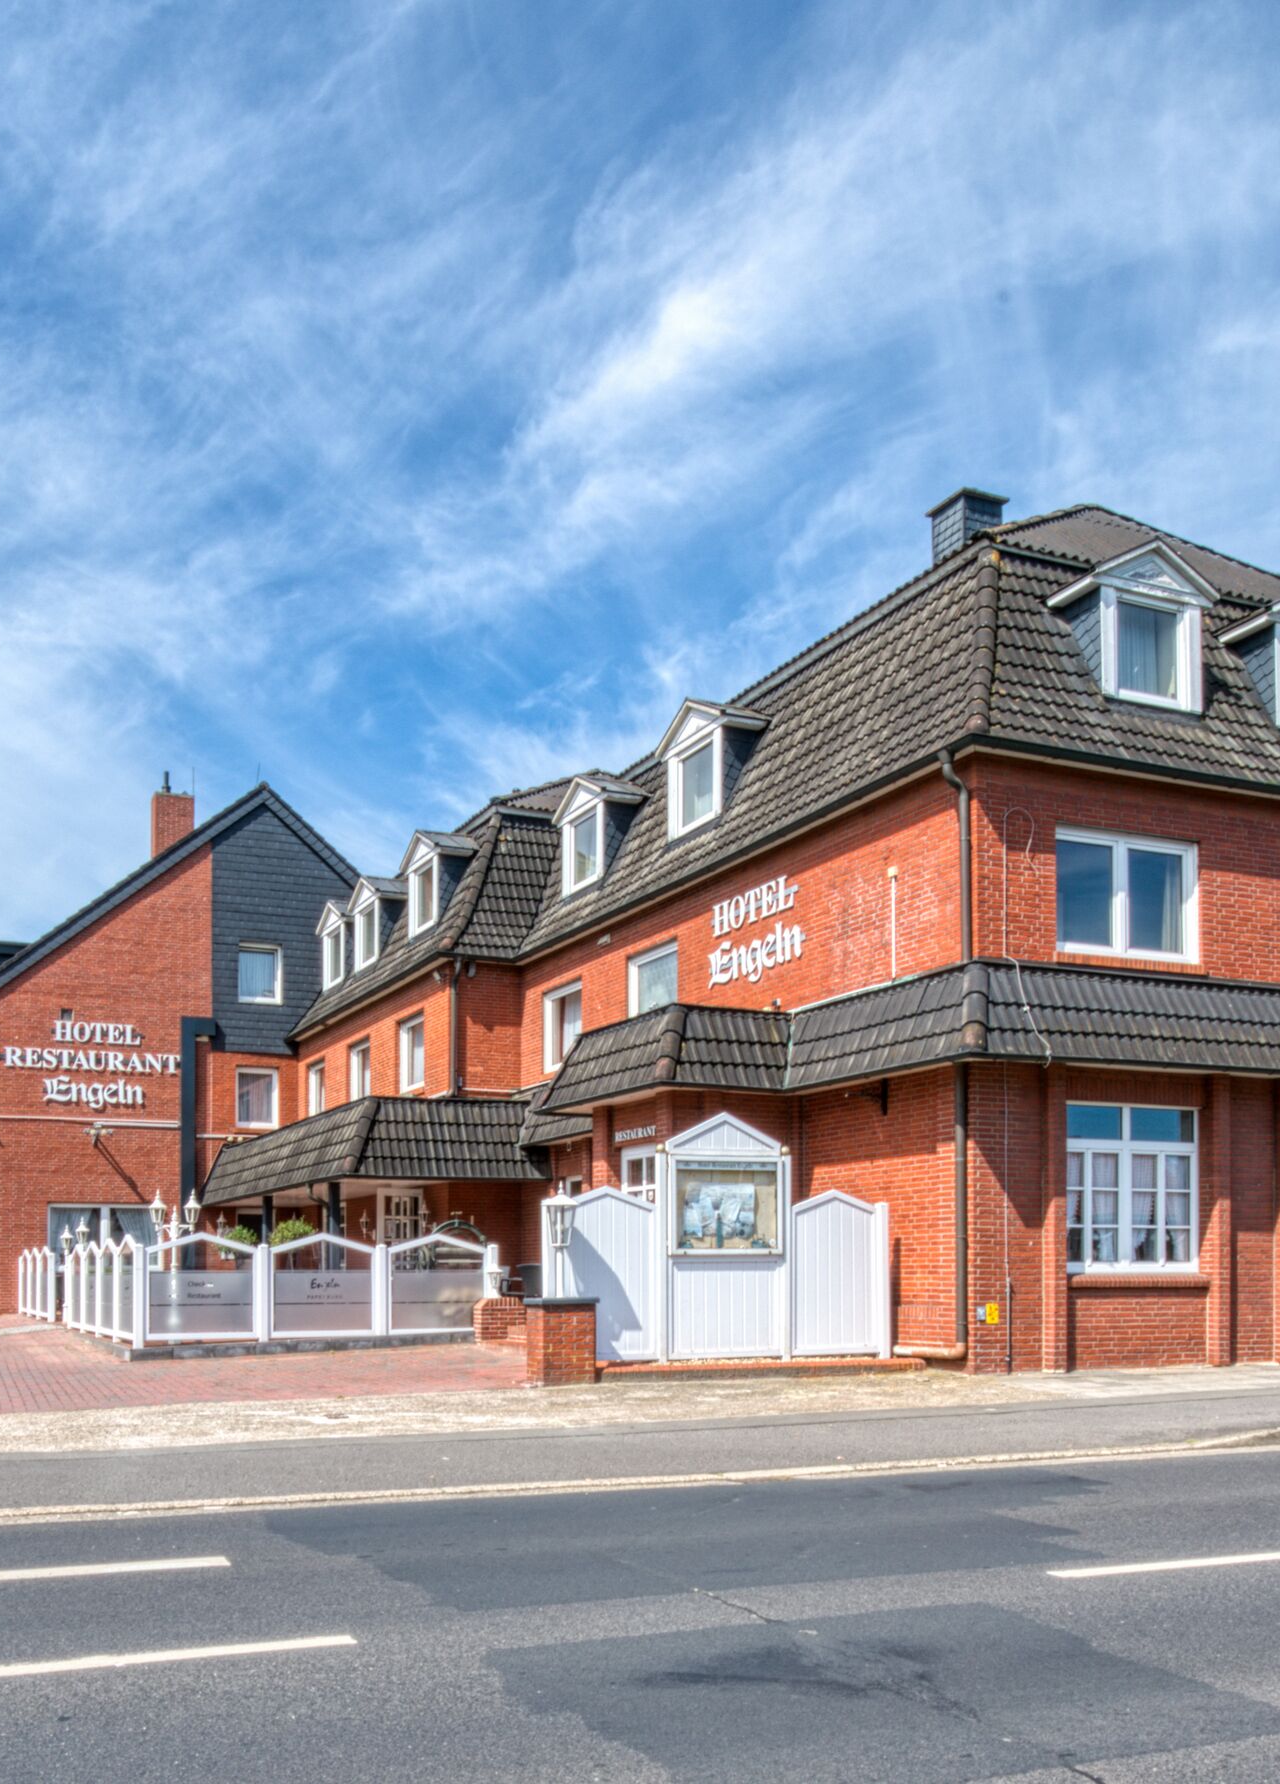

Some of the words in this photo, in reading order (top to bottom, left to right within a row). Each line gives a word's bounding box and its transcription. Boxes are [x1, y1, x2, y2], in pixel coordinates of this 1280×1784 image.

[712, 875, 795, 937] HOTEL
[707, 921, 803, 989] Engeln
[53, 1020, 141, 1046] HOTEL
[3, 1046, 180, 1074] RESTAURANT
[42, 1075, 144, 1109] Engeln
[614, 1125, 656, 1142] RESTAURANT
